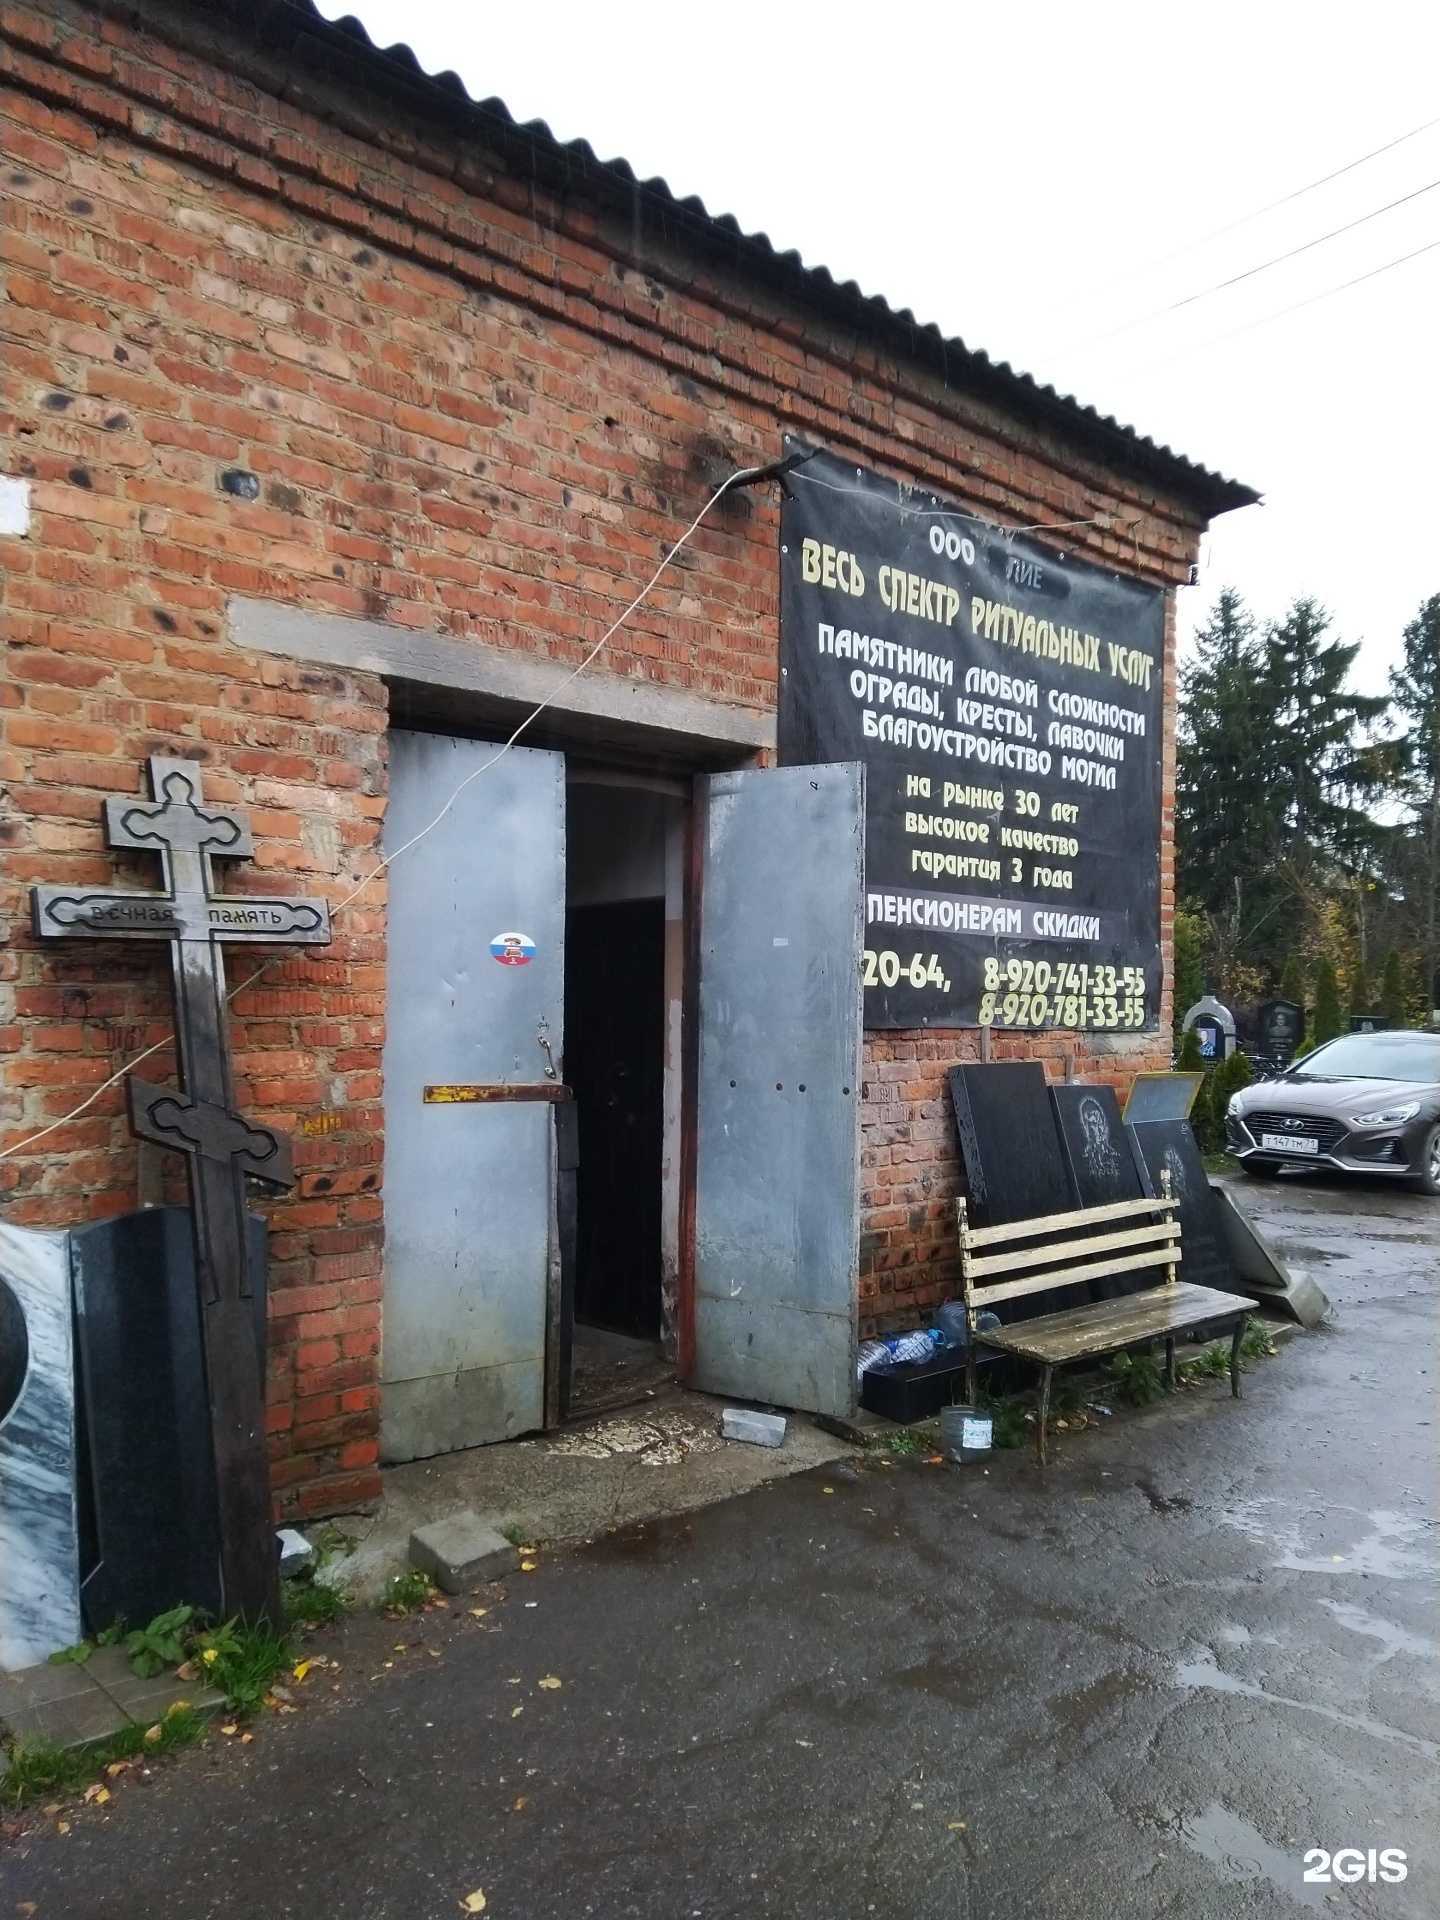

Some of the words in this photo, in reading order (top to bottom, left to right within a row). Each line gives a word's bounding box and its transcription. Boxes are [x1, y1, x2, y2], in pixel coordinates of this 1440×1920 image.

[929, 524, 975, 566] ООО
[801, 538, 866, 597] ВЕСЬ
[878, 564, 960, 627] СПЕКТР
[970, 596, 1101, 673] РИТУАЛЬНЫХ
[1107, 641, 1155, 692] УСЛУГ
[818, 623, 954, 686] ПАМЯТНИКИ
[965, 667, 1038, 708] ЛЮБОЙ
[1048, 690, 1146, 736] СЛОЖНОСТИ
[850, 669, 945, 721] ОГРАДЫ,
[957, 697, 1038, 742] КРЕСТЫ,
[1048, 721, 1124, 761] ЛАВОЧКИ
[862, 709, 1052, 775] БЛАГОУСТРОЙСТВО
[1061, 755, 1117, 791] МОГИЛ
[907, 774, 931, 799] на
[943, 781, 1004, 811] рынке
[1015, 789, 1041, 818] 30
[1051, 802, 1080, 824] лет
[905, 811, 990, 844] высокое
[1001, 827, 1080, 857] качество
[911, 849, 1001, 880] гарантия
[1011, 858, 1023, 883] 3
[1033, 866, 1073, 889] года
[208, 909, 282, 924] память
[867, 893, 1022, 934] ПЕНСИОНЕРАМ
[1033, 911, 1100, 941] СКИДКИ
[863, 950, 951, 993] 20-64,
[983, 956, 1146, 996] 8-920-741-33-55
[977, 993, 1146, 1027] 8-920-781-33-55
